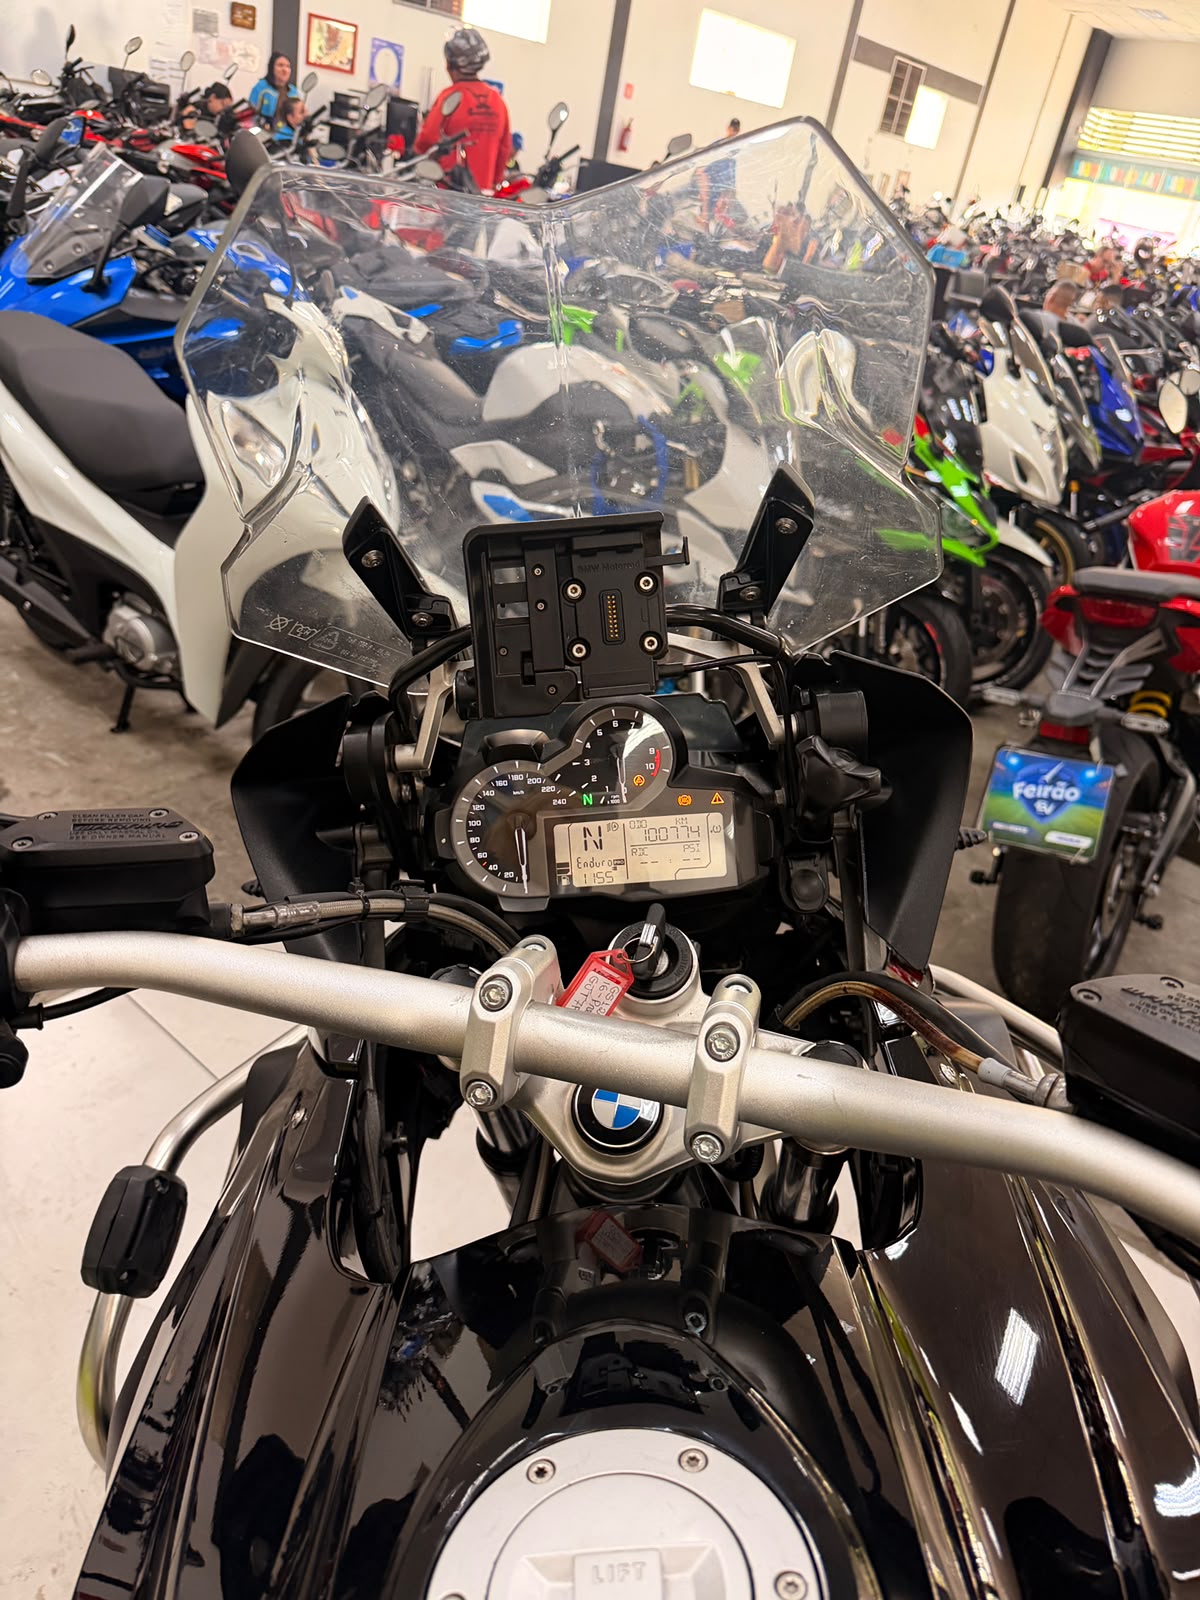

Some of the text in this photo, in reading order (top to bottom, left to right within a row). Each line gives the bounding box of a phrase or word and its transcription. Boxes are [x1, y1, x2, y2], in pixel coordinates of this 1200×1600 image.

[1012, 780, 1081, 802] Feirão
[582, 793, 592, 805] N
[675, 817, 688, 825] KM
[583, 825, 603, 851] N
[644, 826, 700, 842] 100774
[683, 844, 701, 853] PSI
[576, 857, 612, 869] Enduro
[592, 1561, 647, 1584] LIFT
